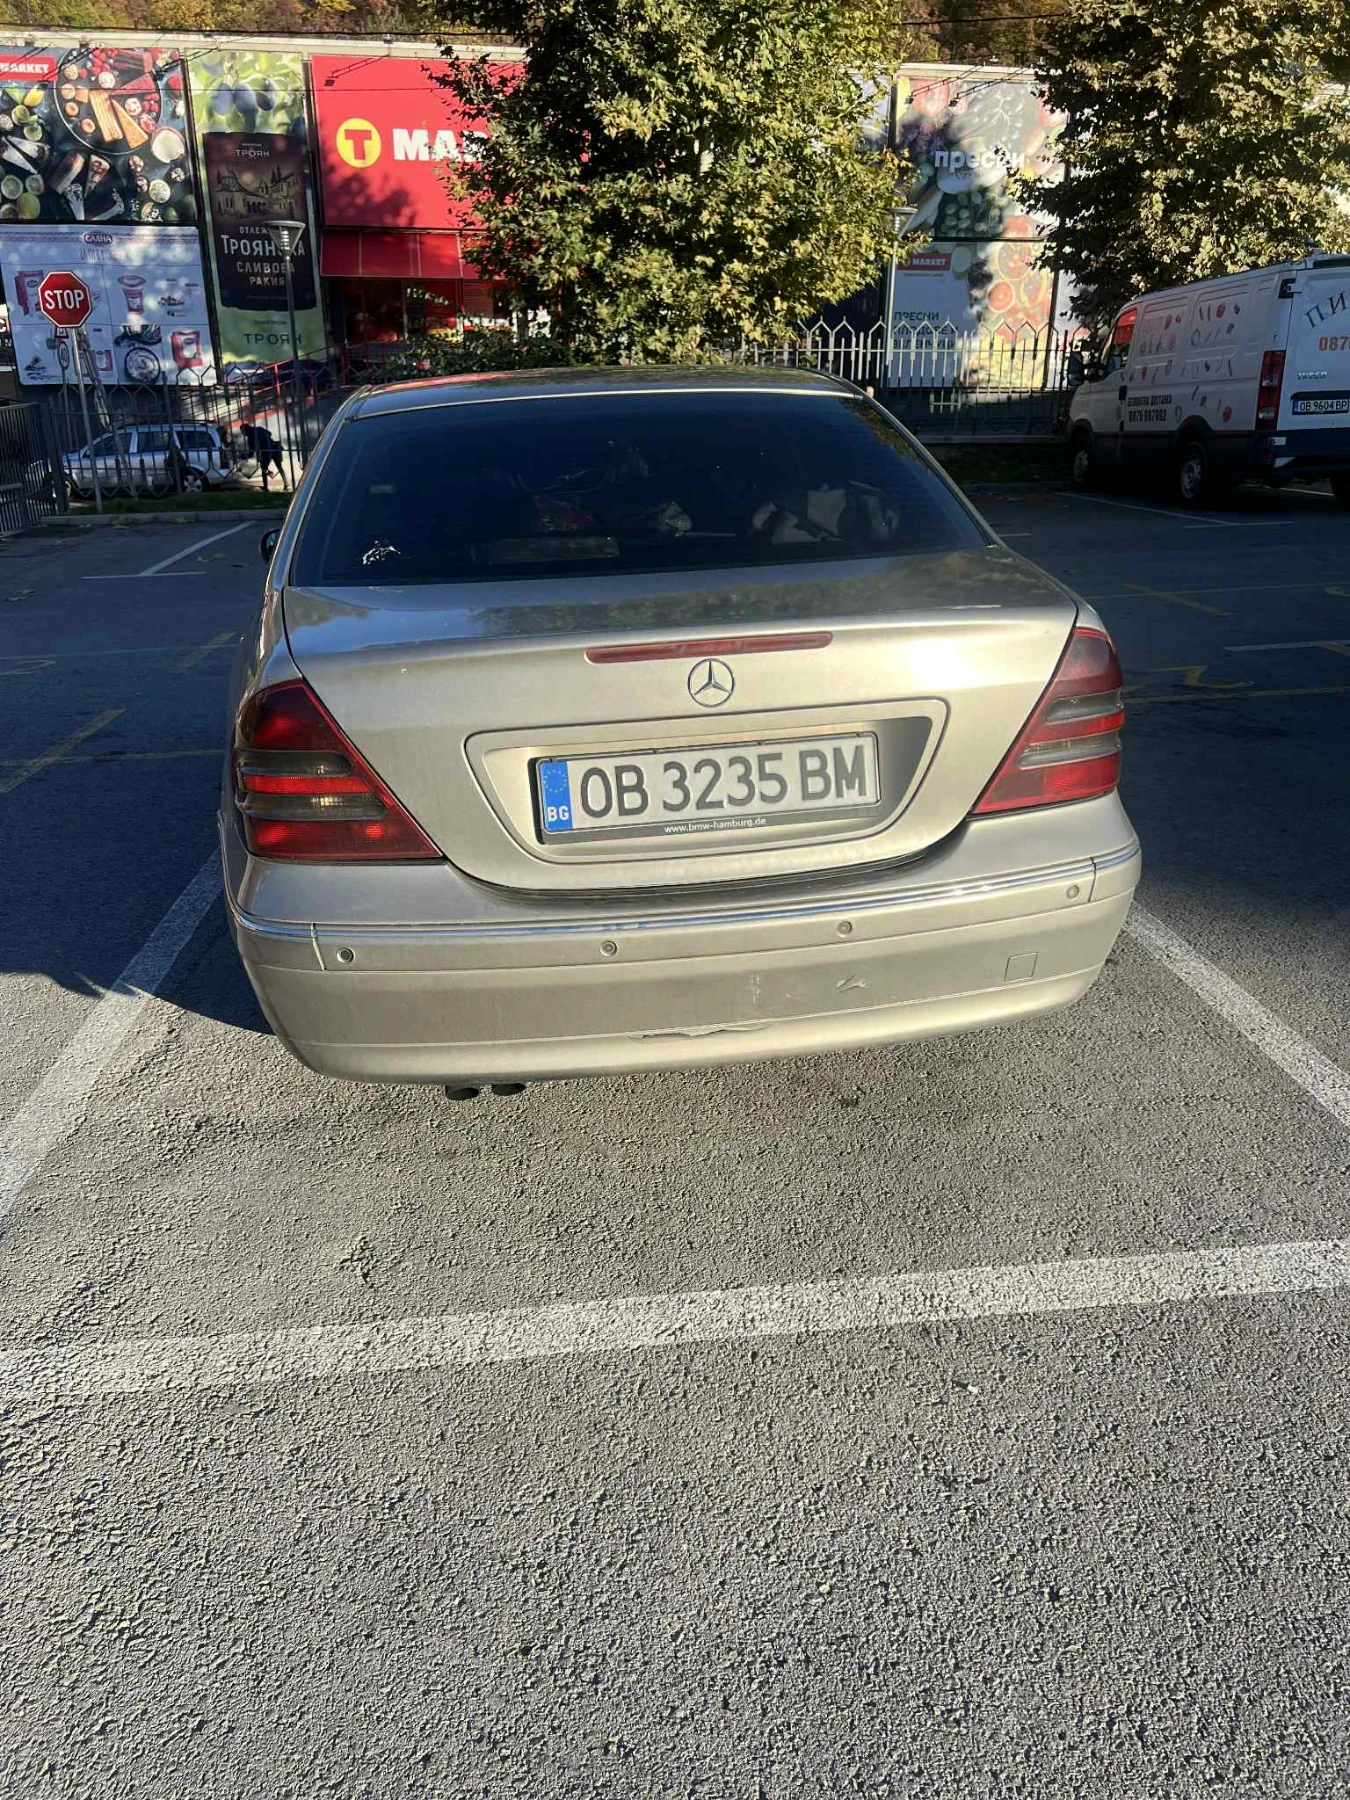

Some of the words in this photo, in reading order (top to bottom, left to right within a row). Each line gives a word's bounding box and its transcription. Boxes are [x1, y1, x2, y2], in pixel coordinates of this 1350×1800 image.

[0, 63, 49, 74] MARKET
[912, 258, 946, 266] MARKET
[44, 289, 85, 310] STOP
[893, 311, 940, 321] ПРЕСНИ
[1313, 401, 1334, 411] 9604
[580, 765, 650, 819] OB
[663, 752, 788, 814] 3235
[799, 745, 866, 801] BM
[547, 806, 570, 823] BG
[664, 816, 766, 834] www.bmw-hamburg.de
